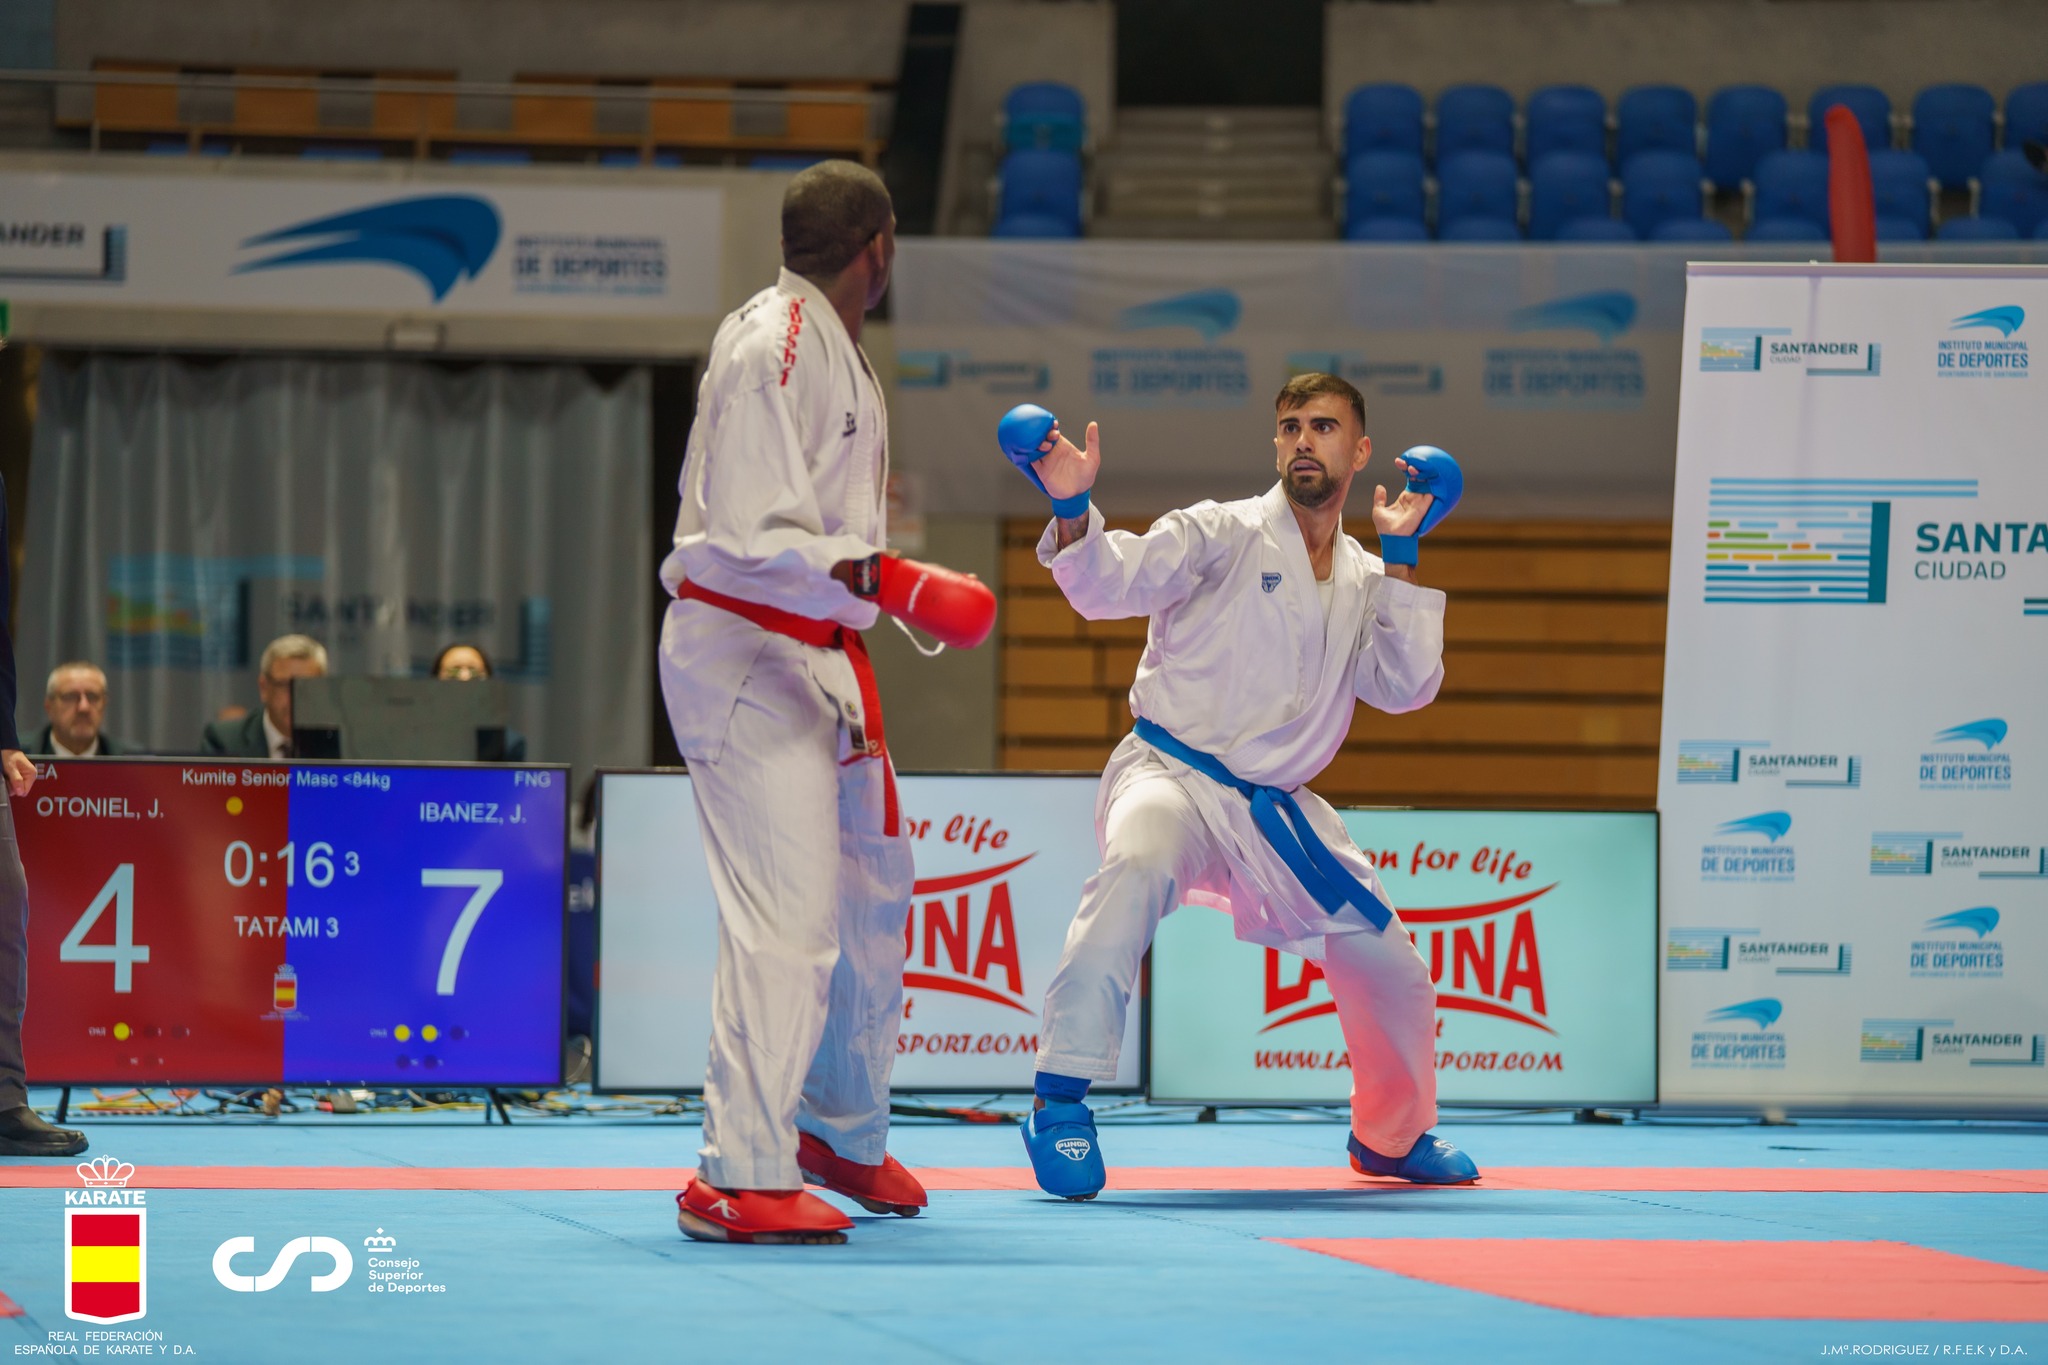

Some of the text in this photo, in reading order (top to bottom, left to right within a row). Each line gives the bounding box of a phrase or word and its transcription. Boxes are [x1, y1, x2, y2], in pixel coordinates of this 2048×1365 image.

[1770, 342, 1858, 355] SANTANDER
[1938, 341, 2028, 350] INSTITUTO MUNICIPAL
[1938, 353, 2029, 368] DE DEPORTES
[1915, 521, 2048, 554] SANTA
[1914, 560, 2006, 580] CIUDAD
[1748, 754, 1838, 768] SANTANDER
[1920, 753, 2010, 763] INSTITUTO MUNICIPAL
[182, 769, 391, 791] Kumite Senior Masc <84kg
[514, 771, 551, 788] FNG
[1920, 764, 2012, 780] DE DEPORTES
[37, 796, 164, 819] OTONIEL, J.
[510, 804, 527, 824] J.
[943, 814, 1009, 853] life
[1941, 846, 2030, 859] SANTANDER
[224, 840, 360, 888] 0:16 3
[1410, 842, 1460, 876] for
[1471, 847, 1533, 883] life
[1701, 857, 1795, 873] DE DEPORTES
[60, 863, 150, 994] 4
[234, 916, 339, 938] TATAMI 3
[421, 868, 503, 996] 7
[1739, 942, 1828, 956] SANTANDER
[1911, 942, 2002, 951] INSTITUTO MUNICIPAL
[1910, 953, 2003, 968] DE DEPORTES
[1932, 1034, 2021, 1046] SANTANDER
[1691, 1044, 1786, 1060] DE DEPORTES
